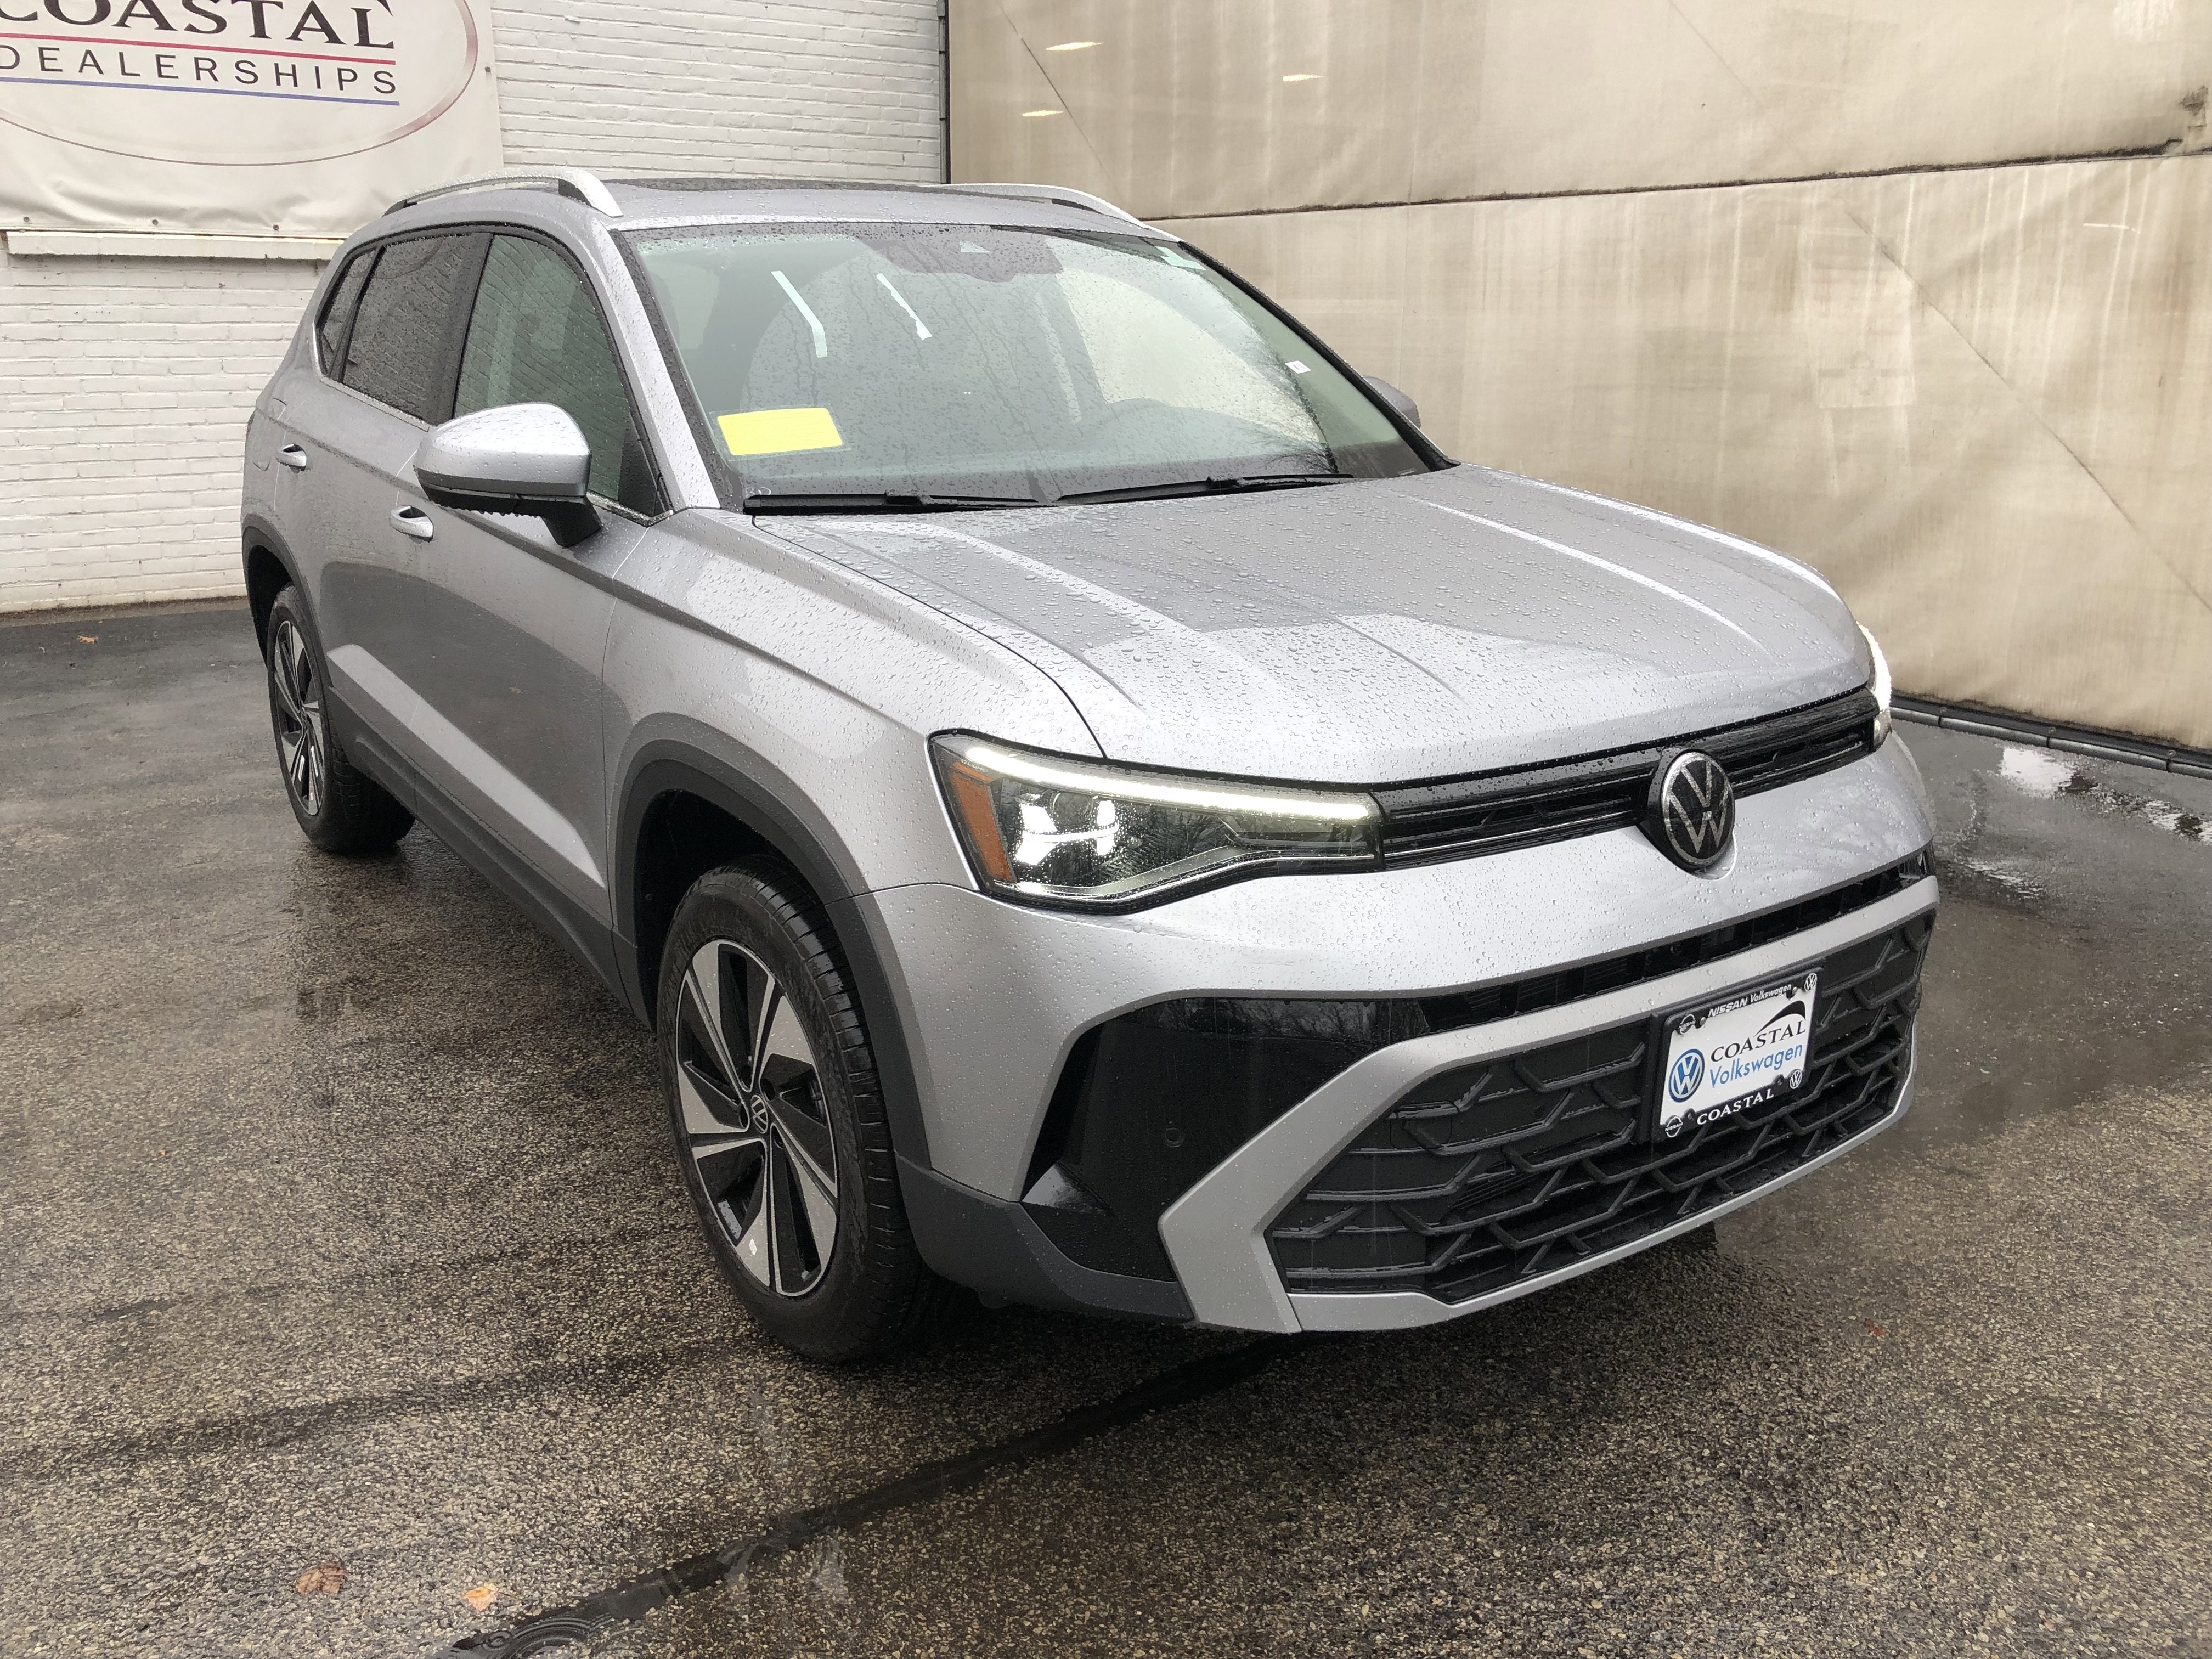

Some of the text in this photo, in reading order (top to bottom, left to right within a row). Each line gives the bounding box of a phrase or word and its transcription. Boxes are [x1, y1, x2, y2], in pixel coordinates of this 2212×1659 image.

[0, 44, 396, 94] DEALERSHIPS
[1708, 984, 1792, 1017] NISSAN Volkswagen
[1711, 1020, 1805, 1062] COASTAL
[1709, 1044, 1803, 1088] Volkswagen
[1697, 1088, 1774, 1125] COASTAL
